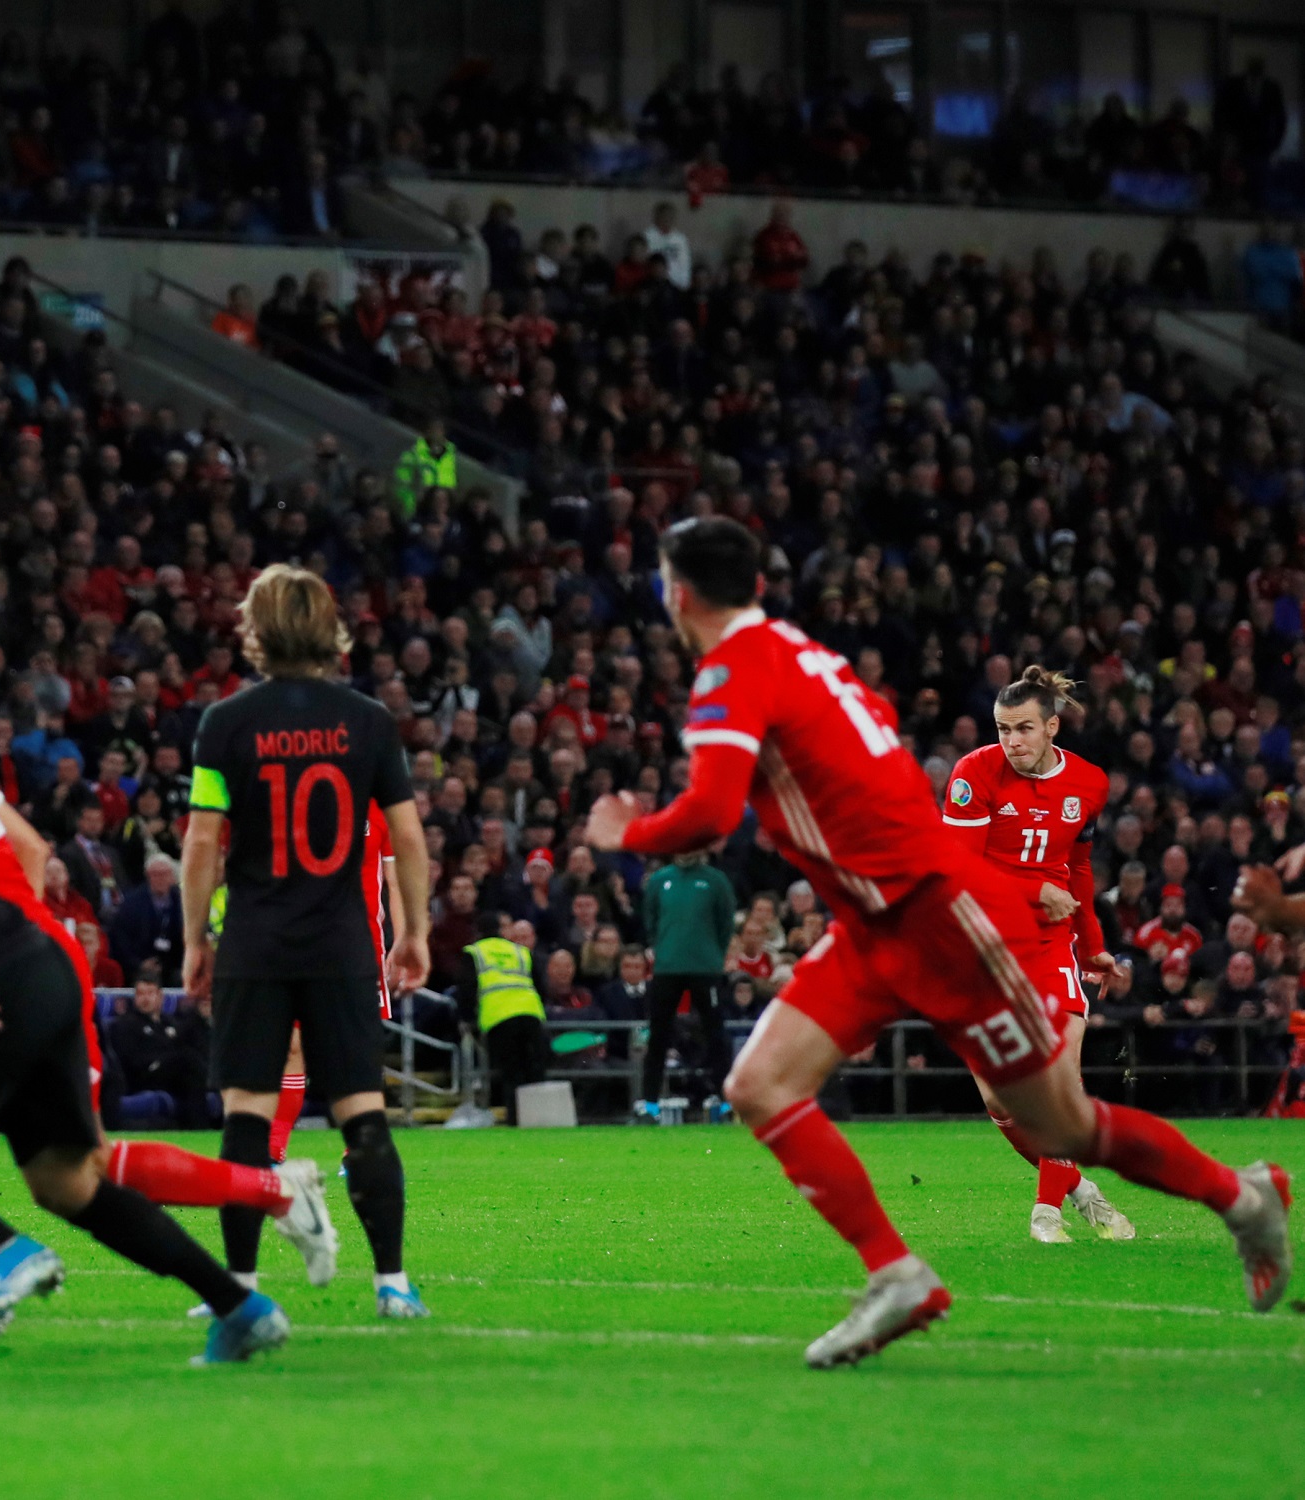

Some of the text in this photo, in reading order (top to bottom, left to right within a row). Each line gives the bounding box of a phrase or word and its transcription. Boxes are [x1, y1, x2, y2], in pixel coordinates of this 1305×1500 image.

[256, 722, 349, 758] MODRIĆ
[258, 763, 354, 878] 10
[1020, 828, 1049, 862] 11
[966, 1009, 1032, 1067] 13
